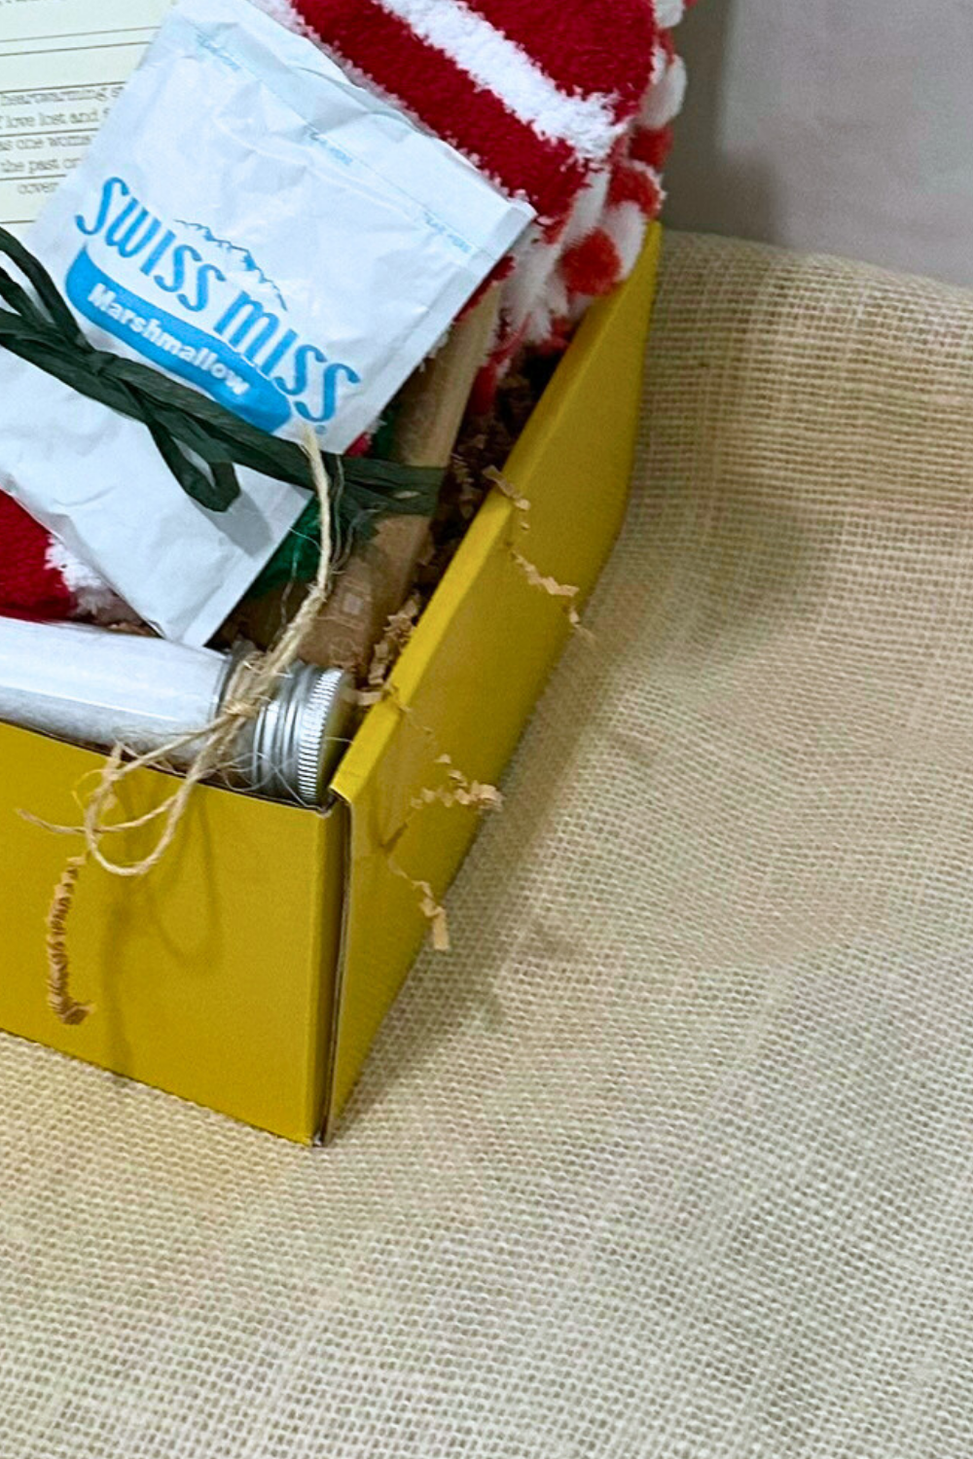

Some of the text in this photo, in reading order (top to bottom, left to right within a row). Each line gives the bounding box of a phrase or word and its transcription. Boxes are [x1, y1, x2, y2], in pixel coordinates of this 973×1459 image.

[7, 114, 36, 129] love
[39, 112, 67, 127] lost
[69, 108, 100, 125] and
[47, 133, 95, 148] woma
[0, 158, 25, 174] the
[28, 158, 61, 175] past
[74, 176, 227, 313] SWISS
[86, 281, 251, 397] Marshmallow
